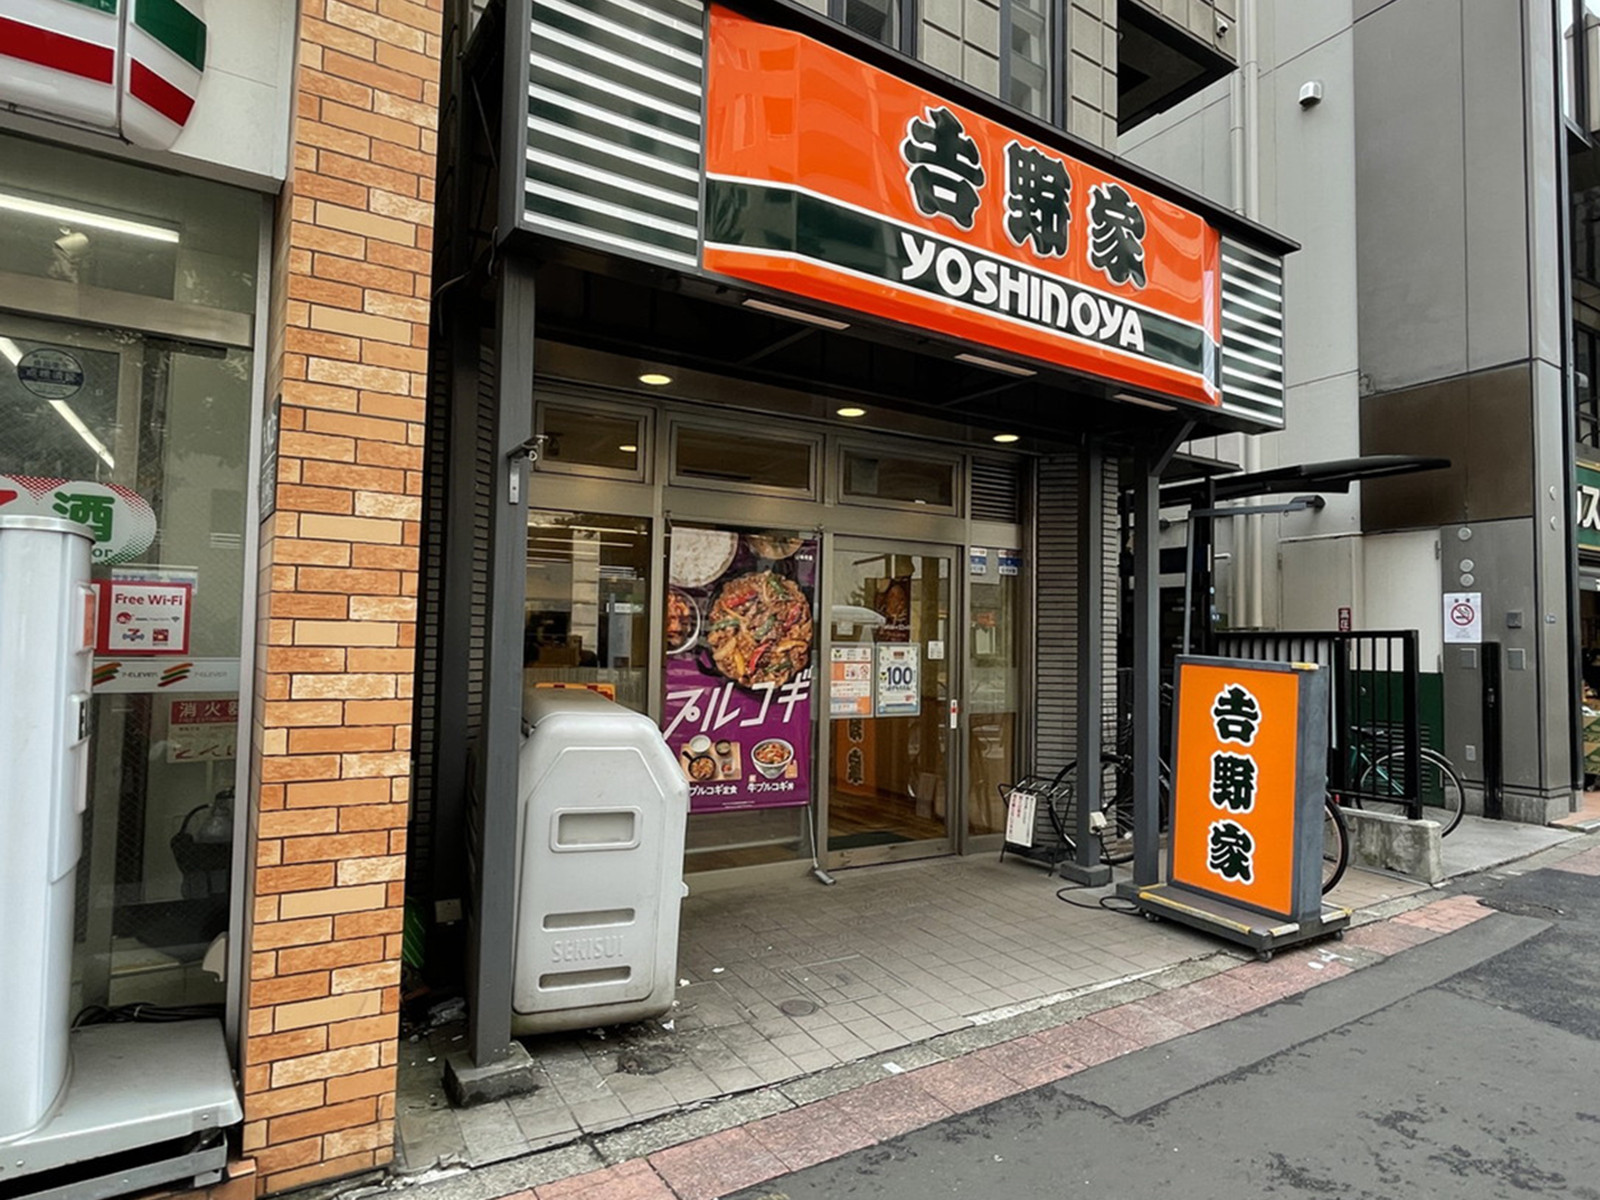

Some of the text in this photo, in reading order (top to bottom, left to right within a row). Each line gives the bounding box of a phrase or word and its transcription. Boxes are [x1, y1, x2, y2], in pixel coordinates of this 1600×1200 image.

[901, 105, 1147, 290] 吉野家
[902, 233, 1145, 352] YOSHINOYA
[52, 491, 115, 543] 酒
[115, 593, 183, 606] Free Wi-Fi
[662, 665, 813, 741] プルコギ
[886, 666, 913, 685] 100
[1207, 683, 1262, 884] 吉野家
